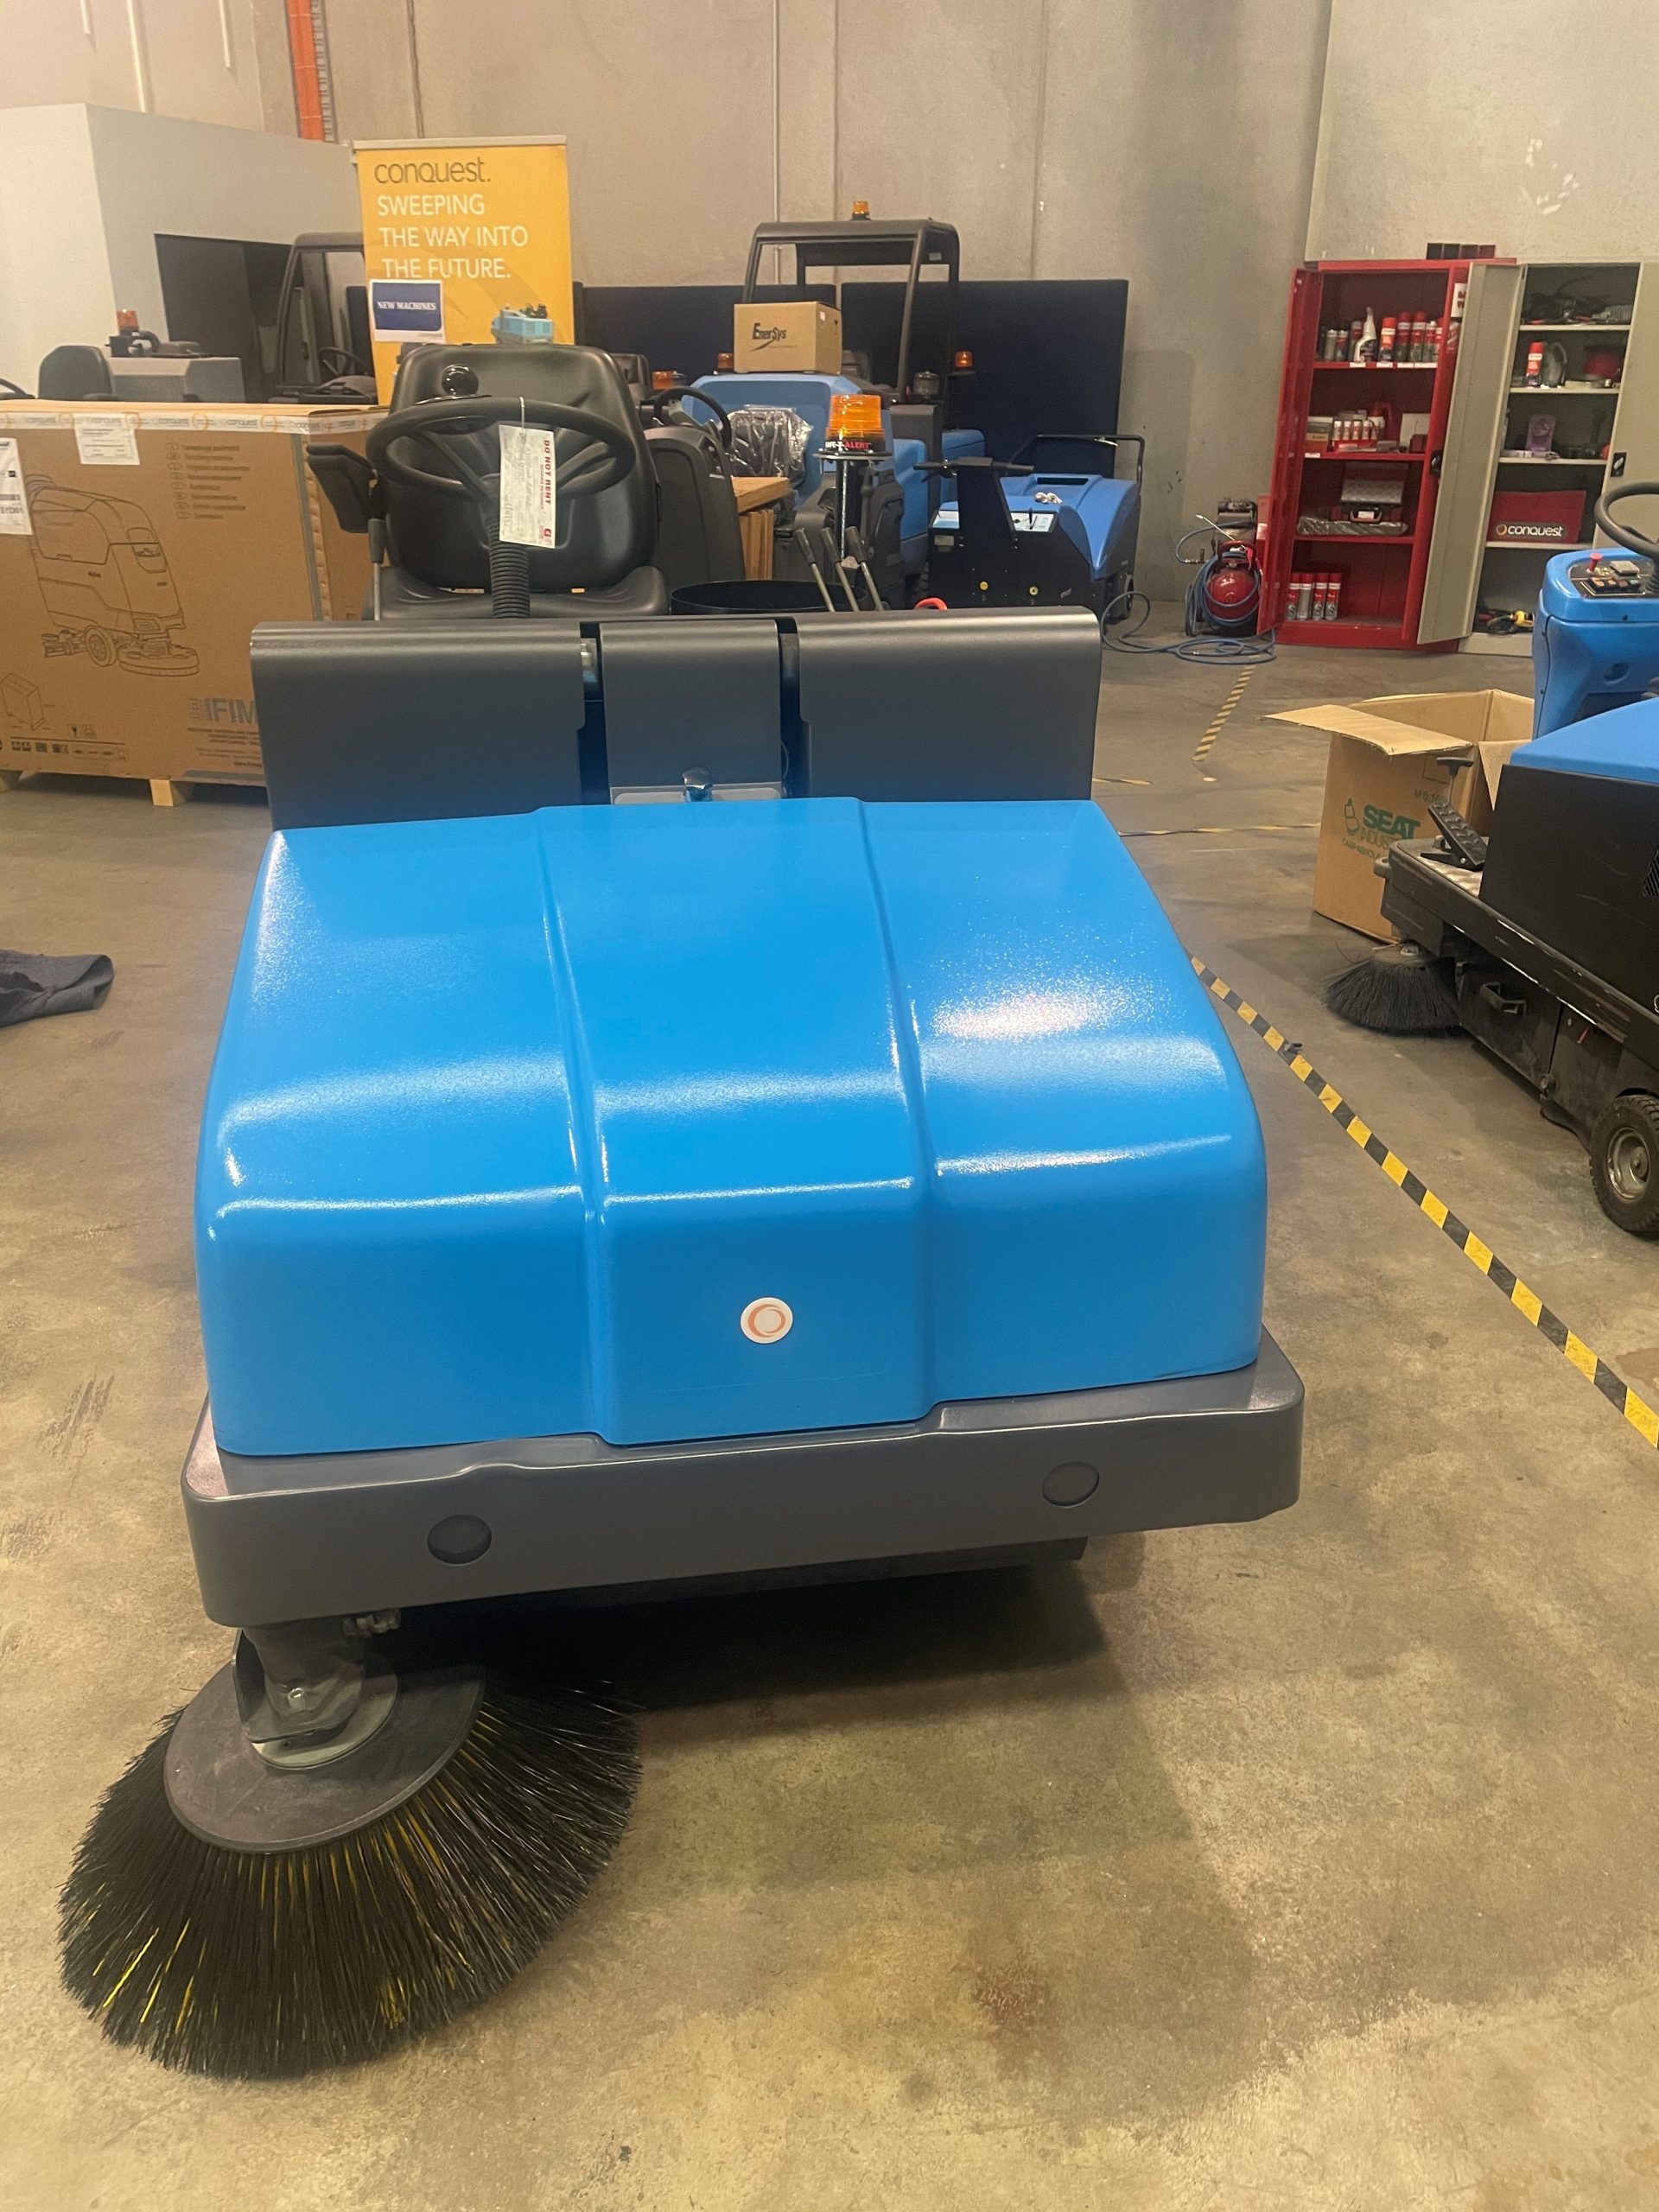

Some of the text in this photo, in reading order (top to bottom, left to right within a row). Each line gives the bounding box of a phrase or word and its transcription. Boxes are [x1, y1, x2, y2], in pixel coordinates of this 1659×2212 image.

[377, 194, 486, 216] SWEEPING
[378, 225, 530, 248] THE WAY INTO
[381, 257, 512, 279] THE FUTURE.
[377, 301, 437, 311] NEW MACHINES
[543, 440, 550, 454] DO
[1507, 524, 1564, 537] conquest
[1363, 804, 1421, 840] SEAT
